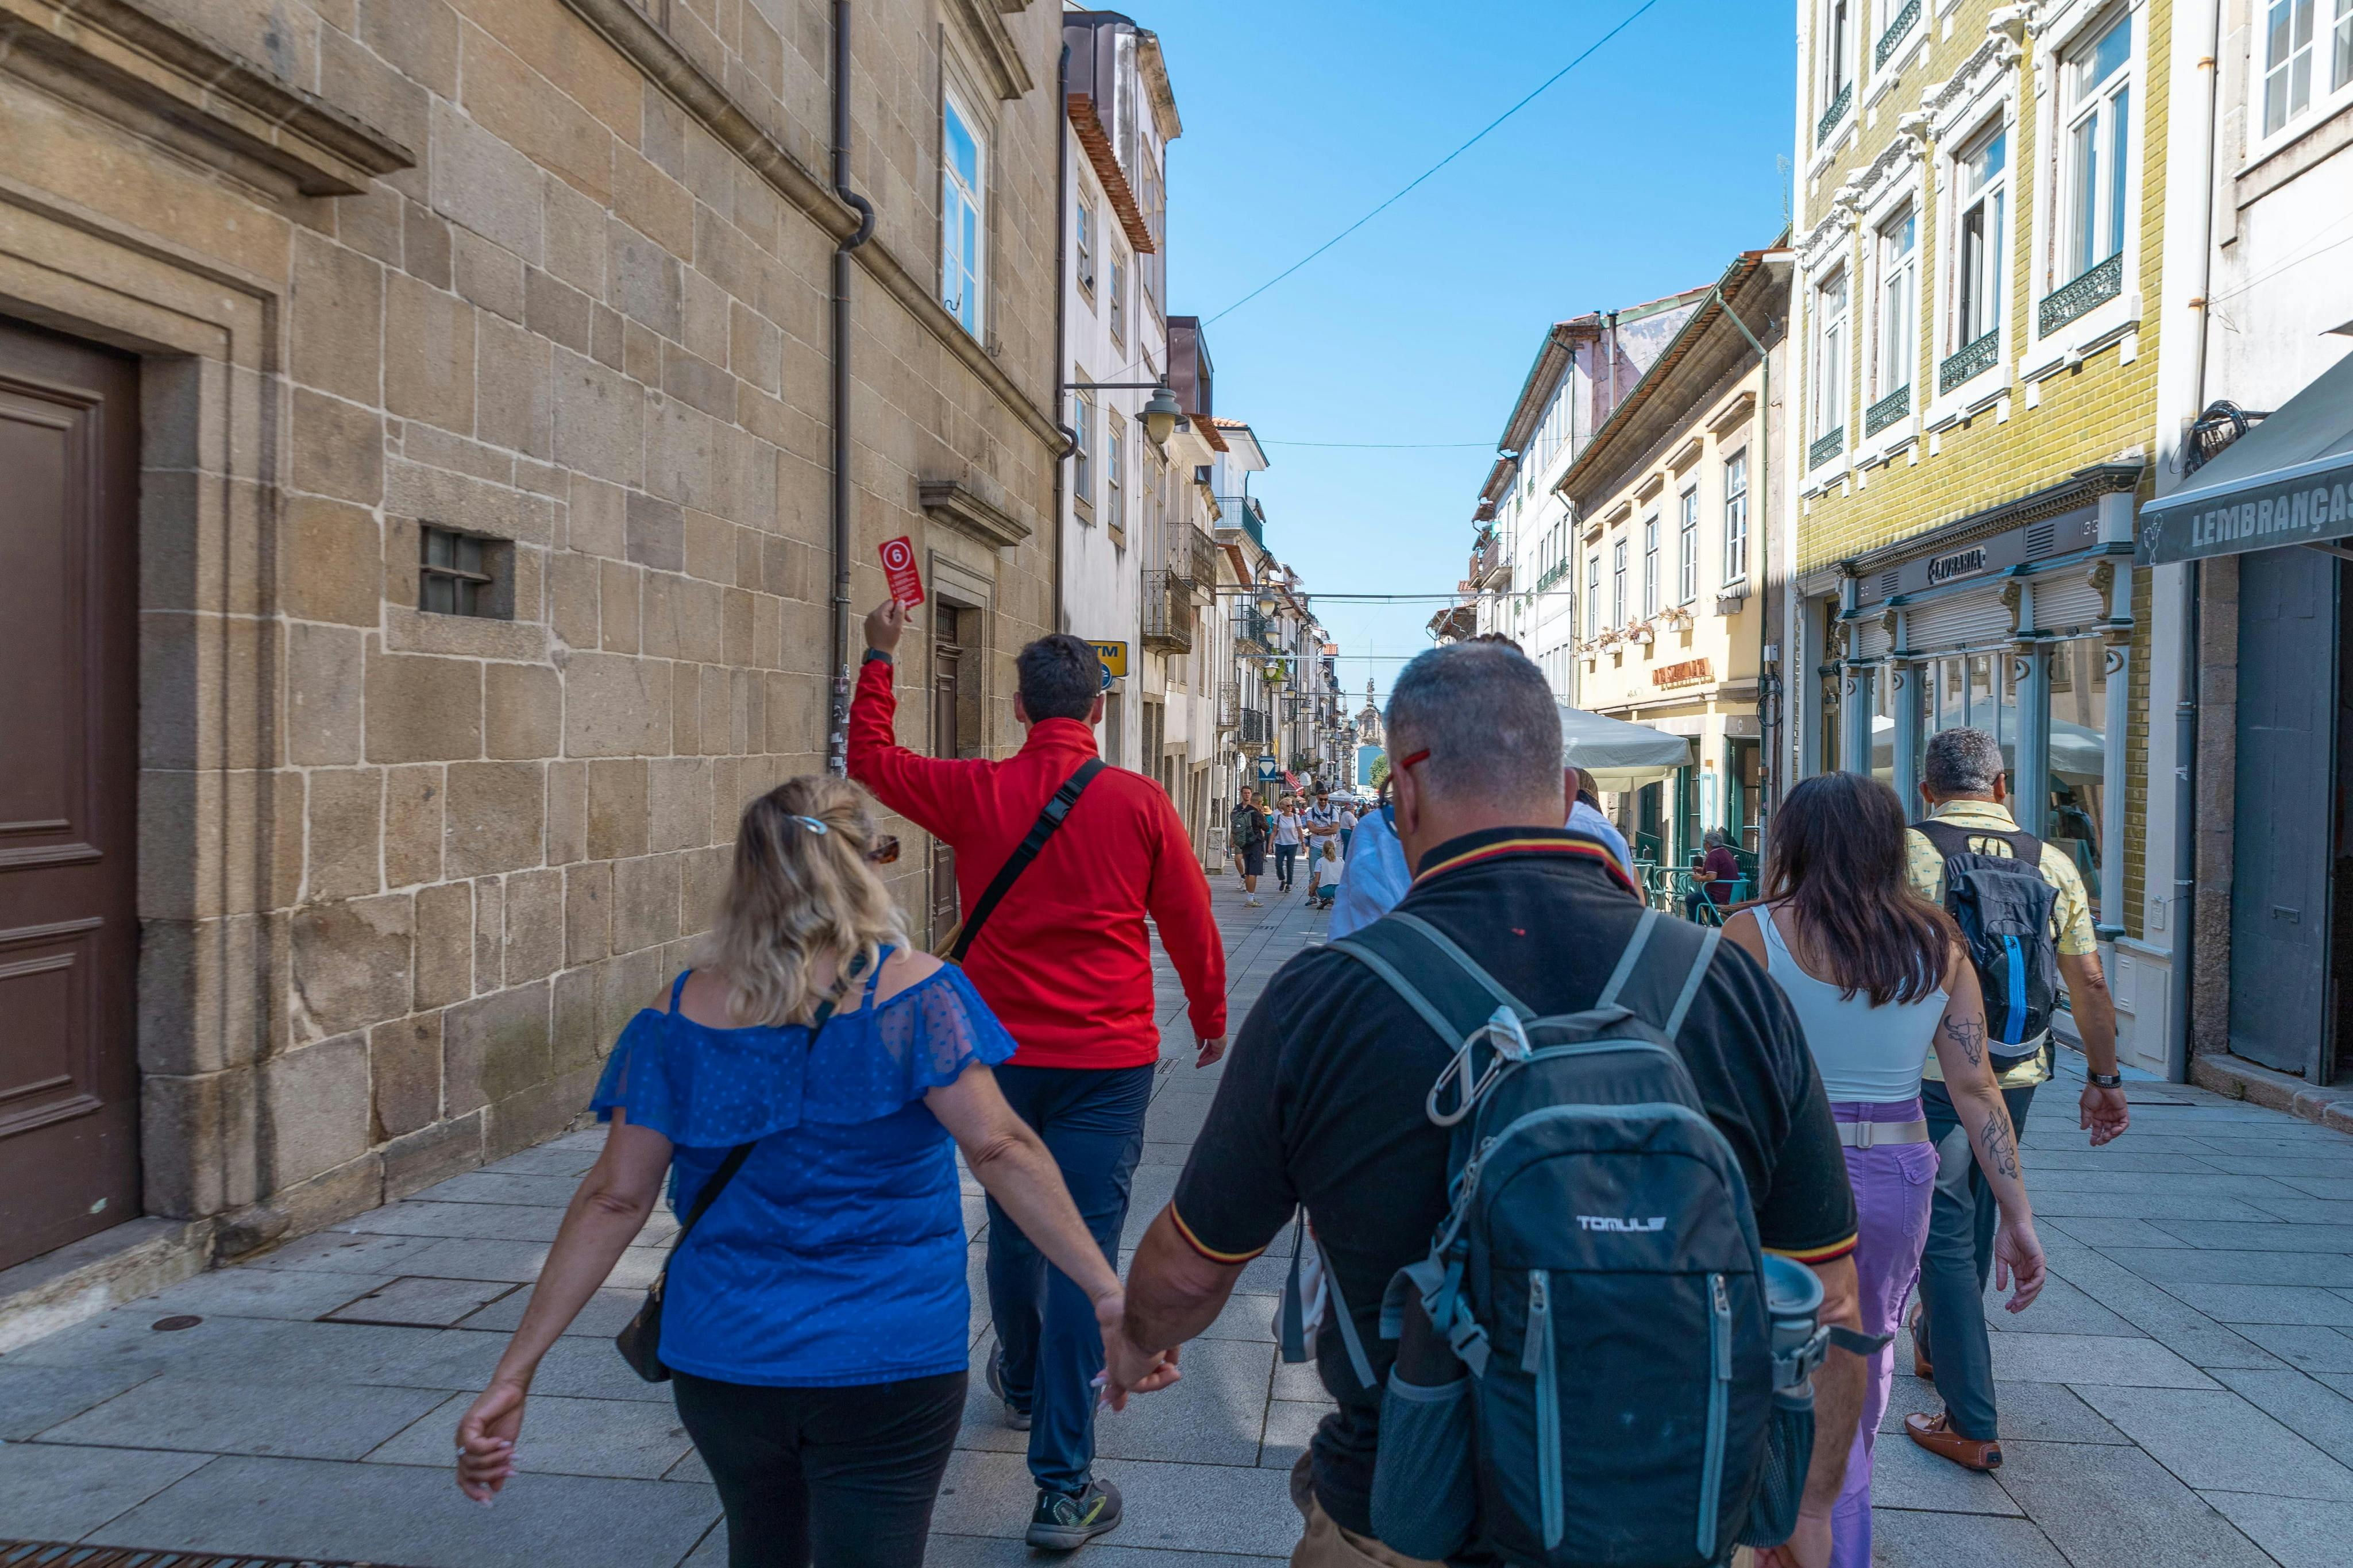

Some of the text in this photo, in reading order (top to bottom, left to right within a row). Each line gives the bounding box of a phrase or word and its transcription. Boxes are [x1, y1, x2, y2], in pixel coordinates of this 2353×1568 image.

[892, 549, 902, 563] 6
[1934, 549, 1982, 581] LIVRARIA
[1576, 1215, 1667, 1231] TOMULE
